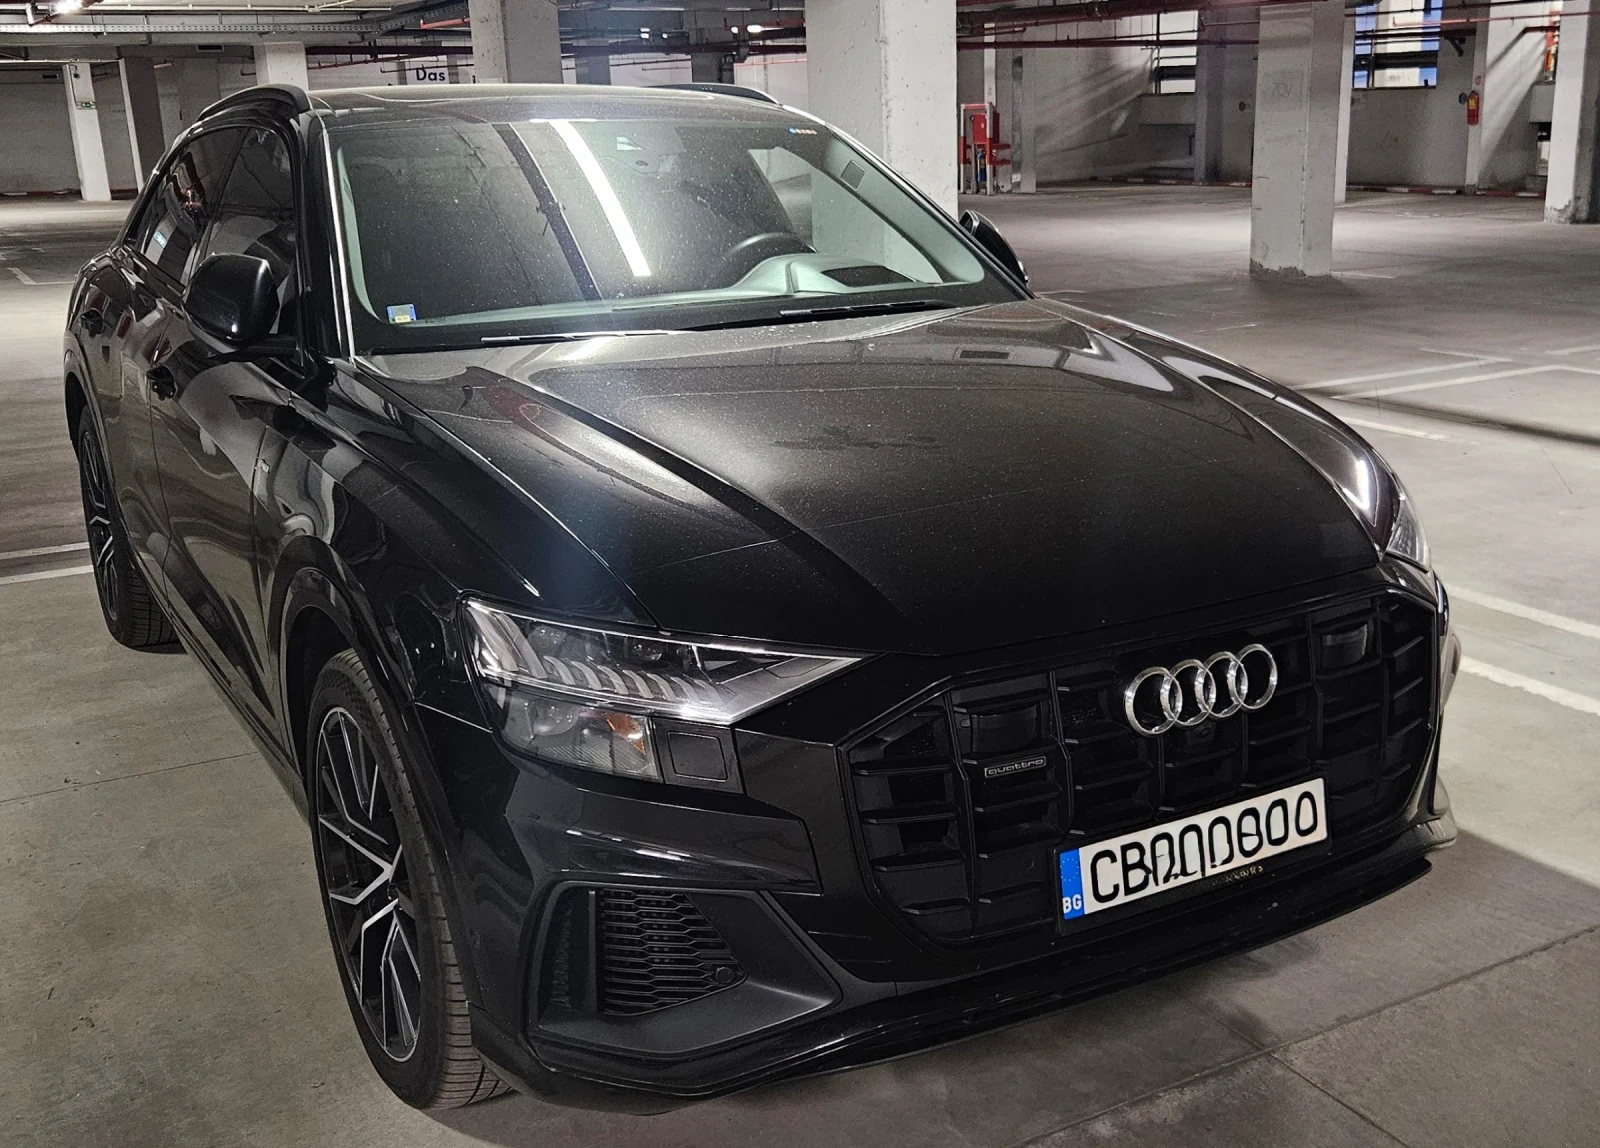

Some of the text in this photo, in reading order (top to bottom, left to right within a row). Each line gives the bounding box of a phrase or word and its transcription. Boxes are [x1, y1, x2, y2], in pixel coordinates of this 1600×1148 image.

[416, 67, 446, 81] Das
[988, 758, 1044, 775] quattro
[1062, 894, 1083, 914] BG
